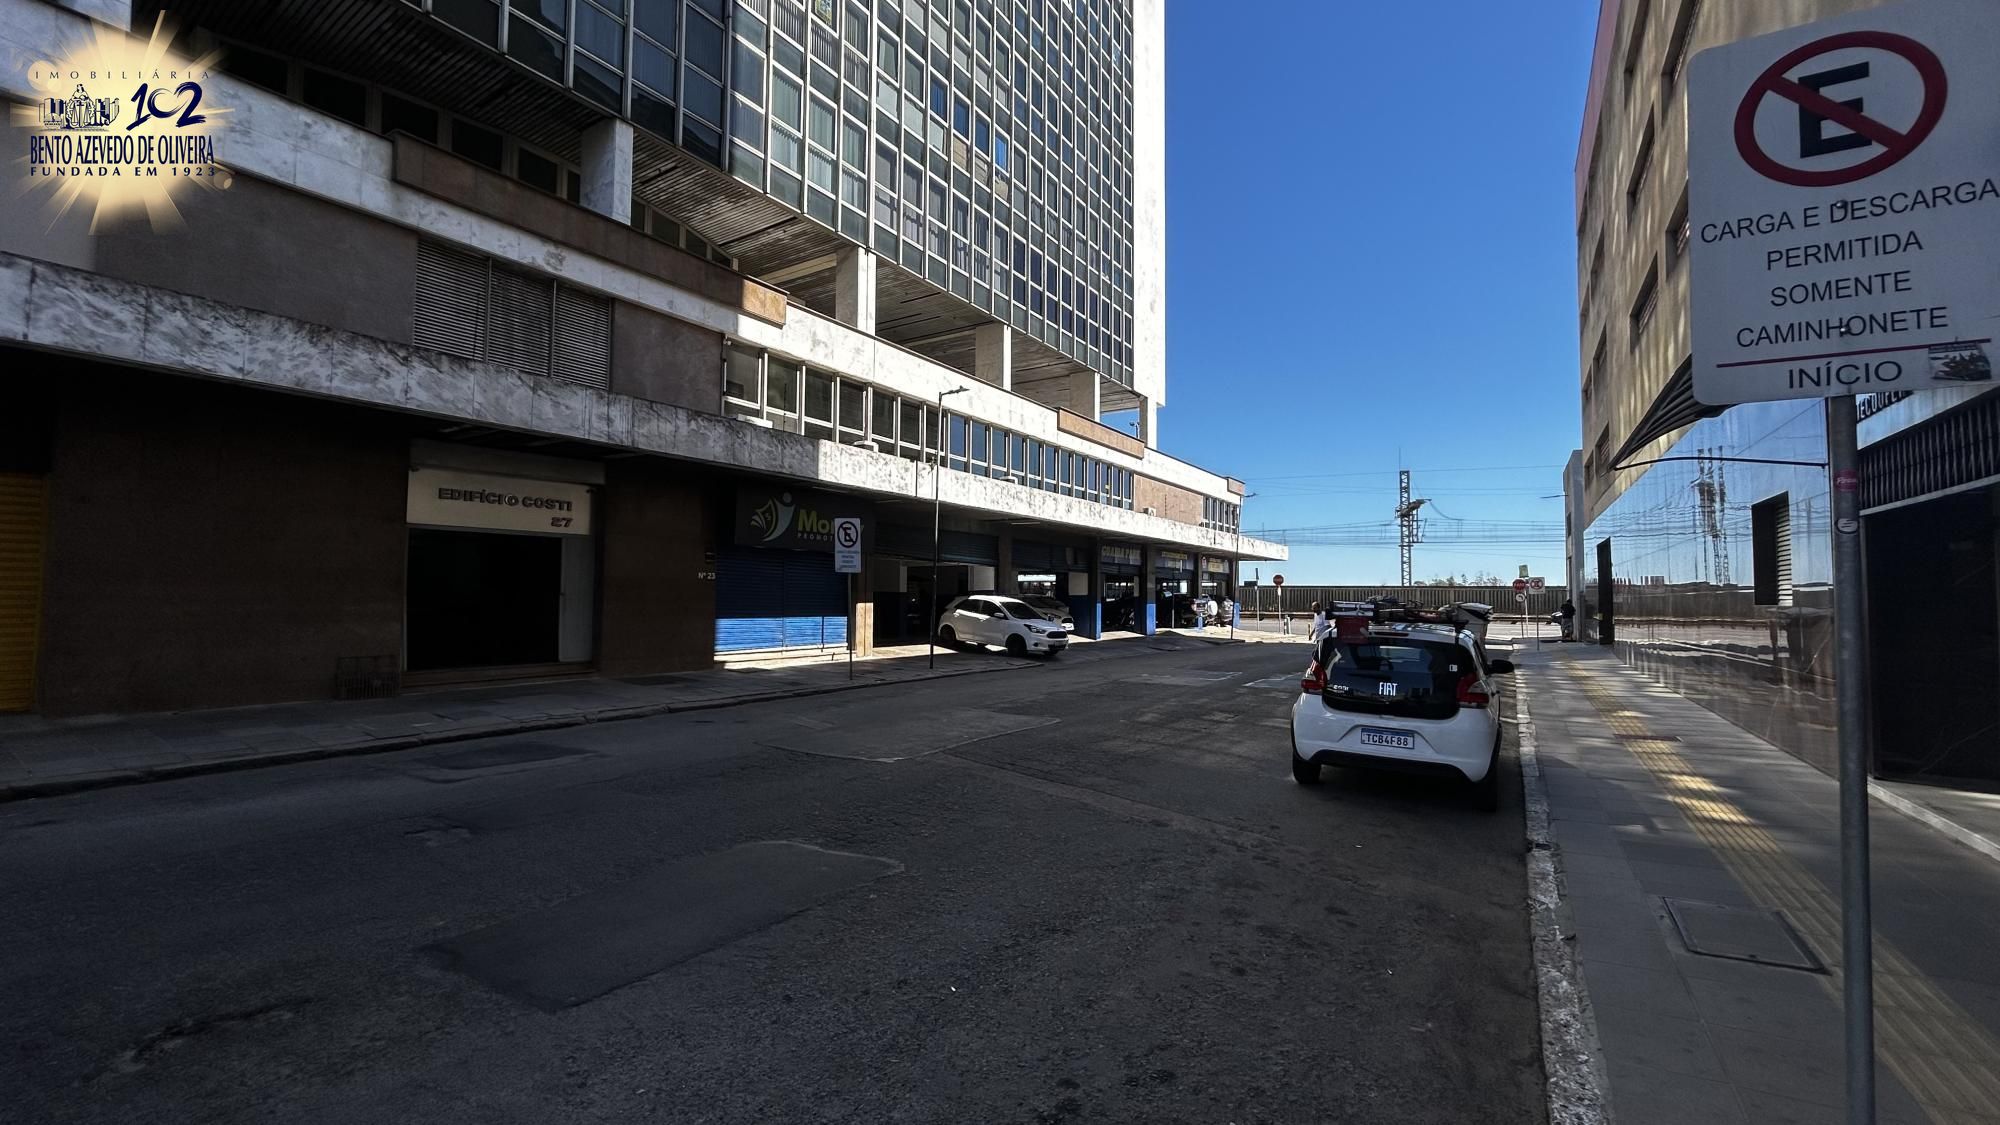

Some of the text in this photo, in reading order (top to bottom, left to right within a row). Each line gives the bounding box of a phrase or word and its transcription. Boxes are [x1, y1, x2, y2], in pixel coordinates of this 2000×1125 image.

[1798, 61, 1872, 158] E
[1701, 178, 2000, 244] CARGA E DESCARGA
[1767, 230, 1923, 270] PERMITIDA
[1770, 270, 1912, 307] SOMENTE
[1736, 307, 1949, 347] CAMINHONETE
[1788, 360, 1903, 389] INÍCIO
[438, 487, 572, 511] EDIFÍCIO COSTI
[551, 517, 573, 527] 27
[797, 533, 835, 542] PROMOT
[1379, 682, 1397, 696] FIAT
[1366, 734, 1409, 746] TCB4F88
